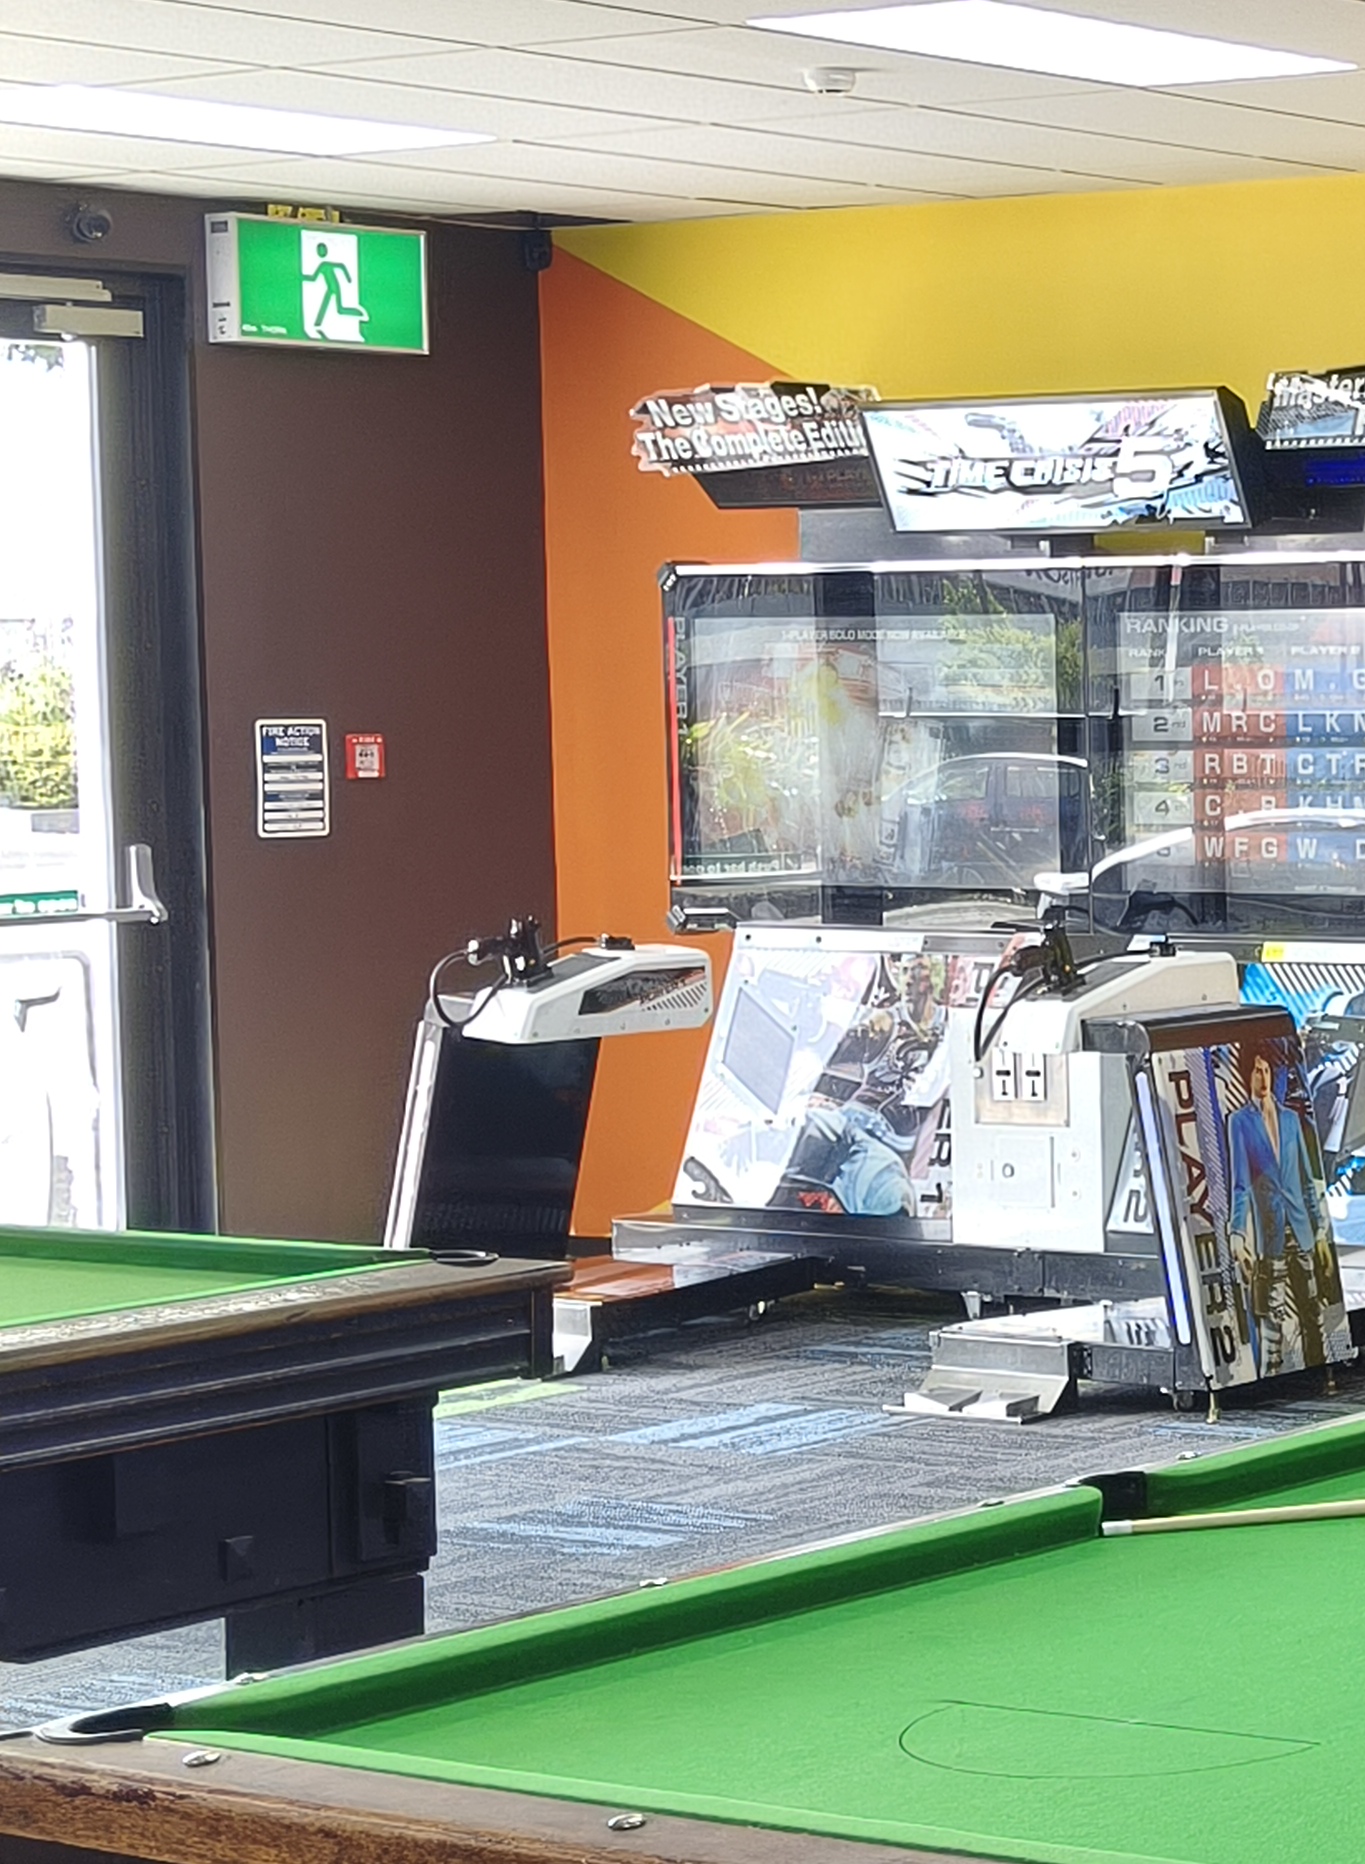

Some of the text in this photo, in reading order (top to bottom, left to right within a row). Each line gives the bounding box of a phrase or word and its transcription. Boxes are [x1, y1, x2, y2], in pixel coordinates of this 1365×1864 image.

[646, 387, 822, 428] New Stages!
[636, 430, 692, 462] The
[691, 422, 806, 458] Complete
[927, 457, 1009, 491] TIME
[1127, 617, 1229, 634] RANKING
[675, 617, 688, 719] PLAYER
[1291, 645, 1347, 657] PLAYER
[1153, 716, 1170, 733] 2
[1154, 799, 1171, 818] 4
[1168, 1069, 1238, 1368] PLAYER 2
